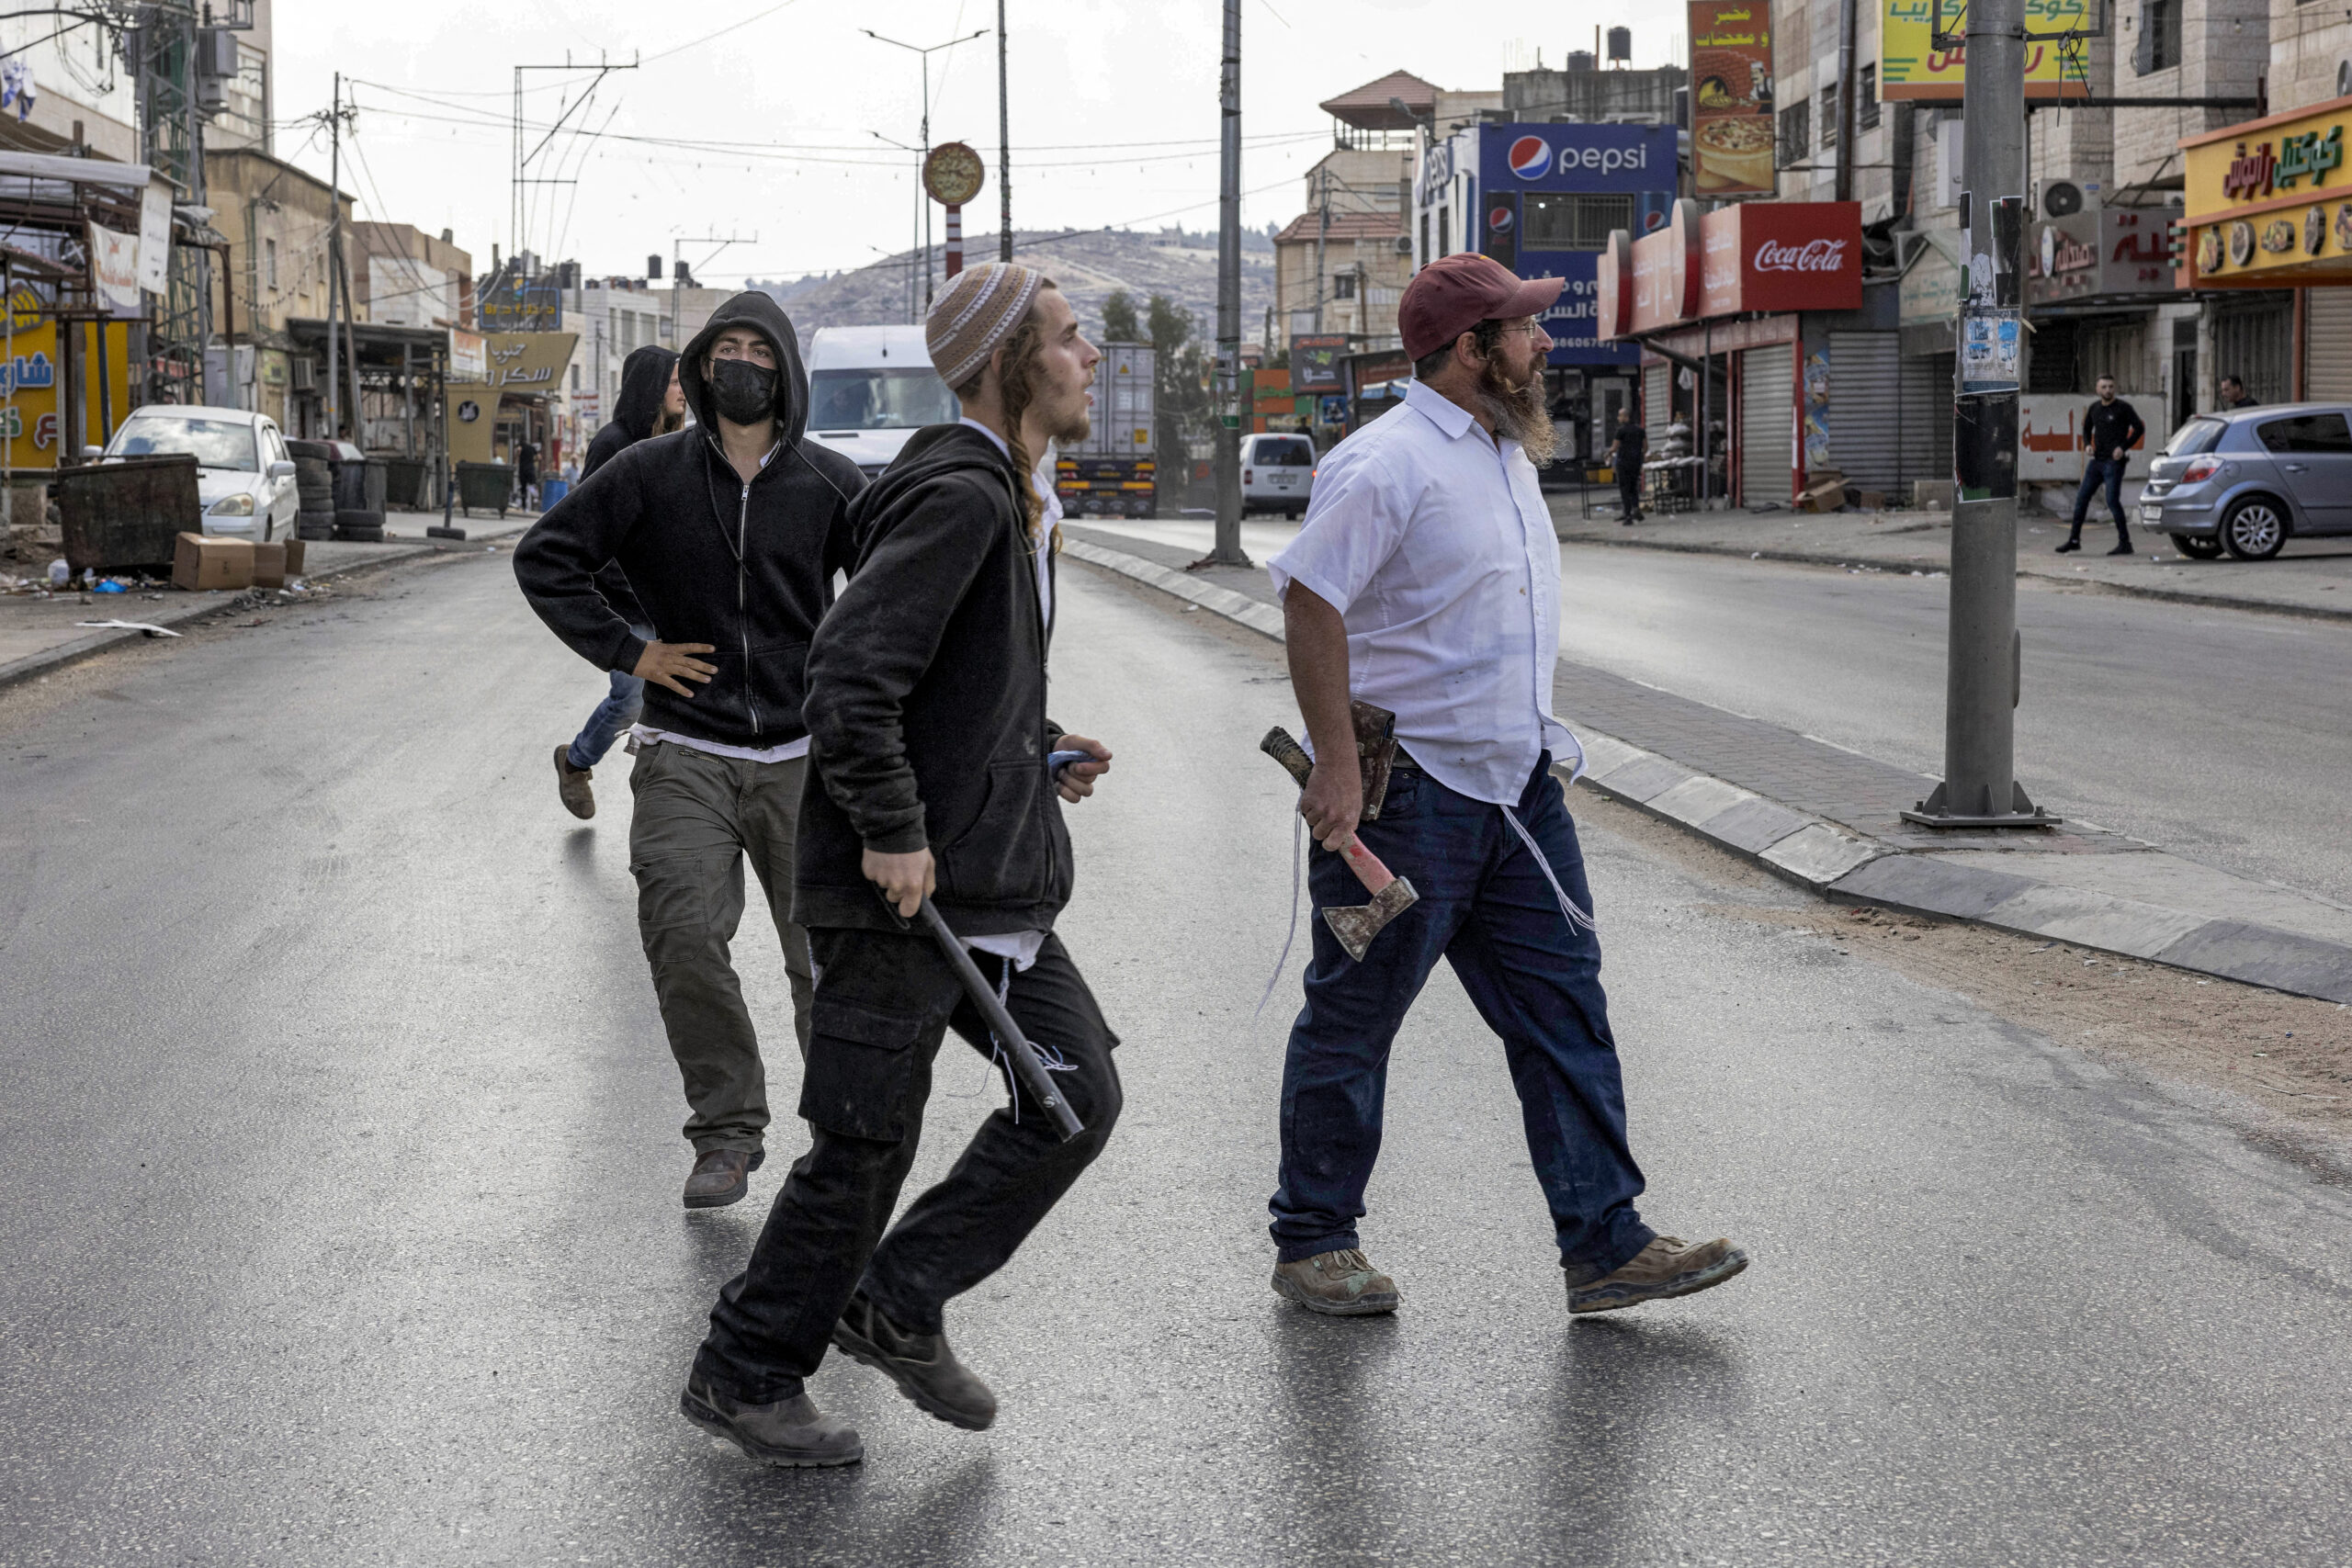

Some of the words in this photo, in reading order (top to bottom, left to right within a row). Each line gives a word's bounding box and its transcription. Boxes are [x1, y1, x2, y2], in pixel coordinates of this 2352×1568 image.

[1713, 5, 1751, 26] مخبز
[1559, 143, 1646, 175] pepsi
[2272, 125, 2344, 189] كوكتيل
[499, 367, 553, 387] سكر
